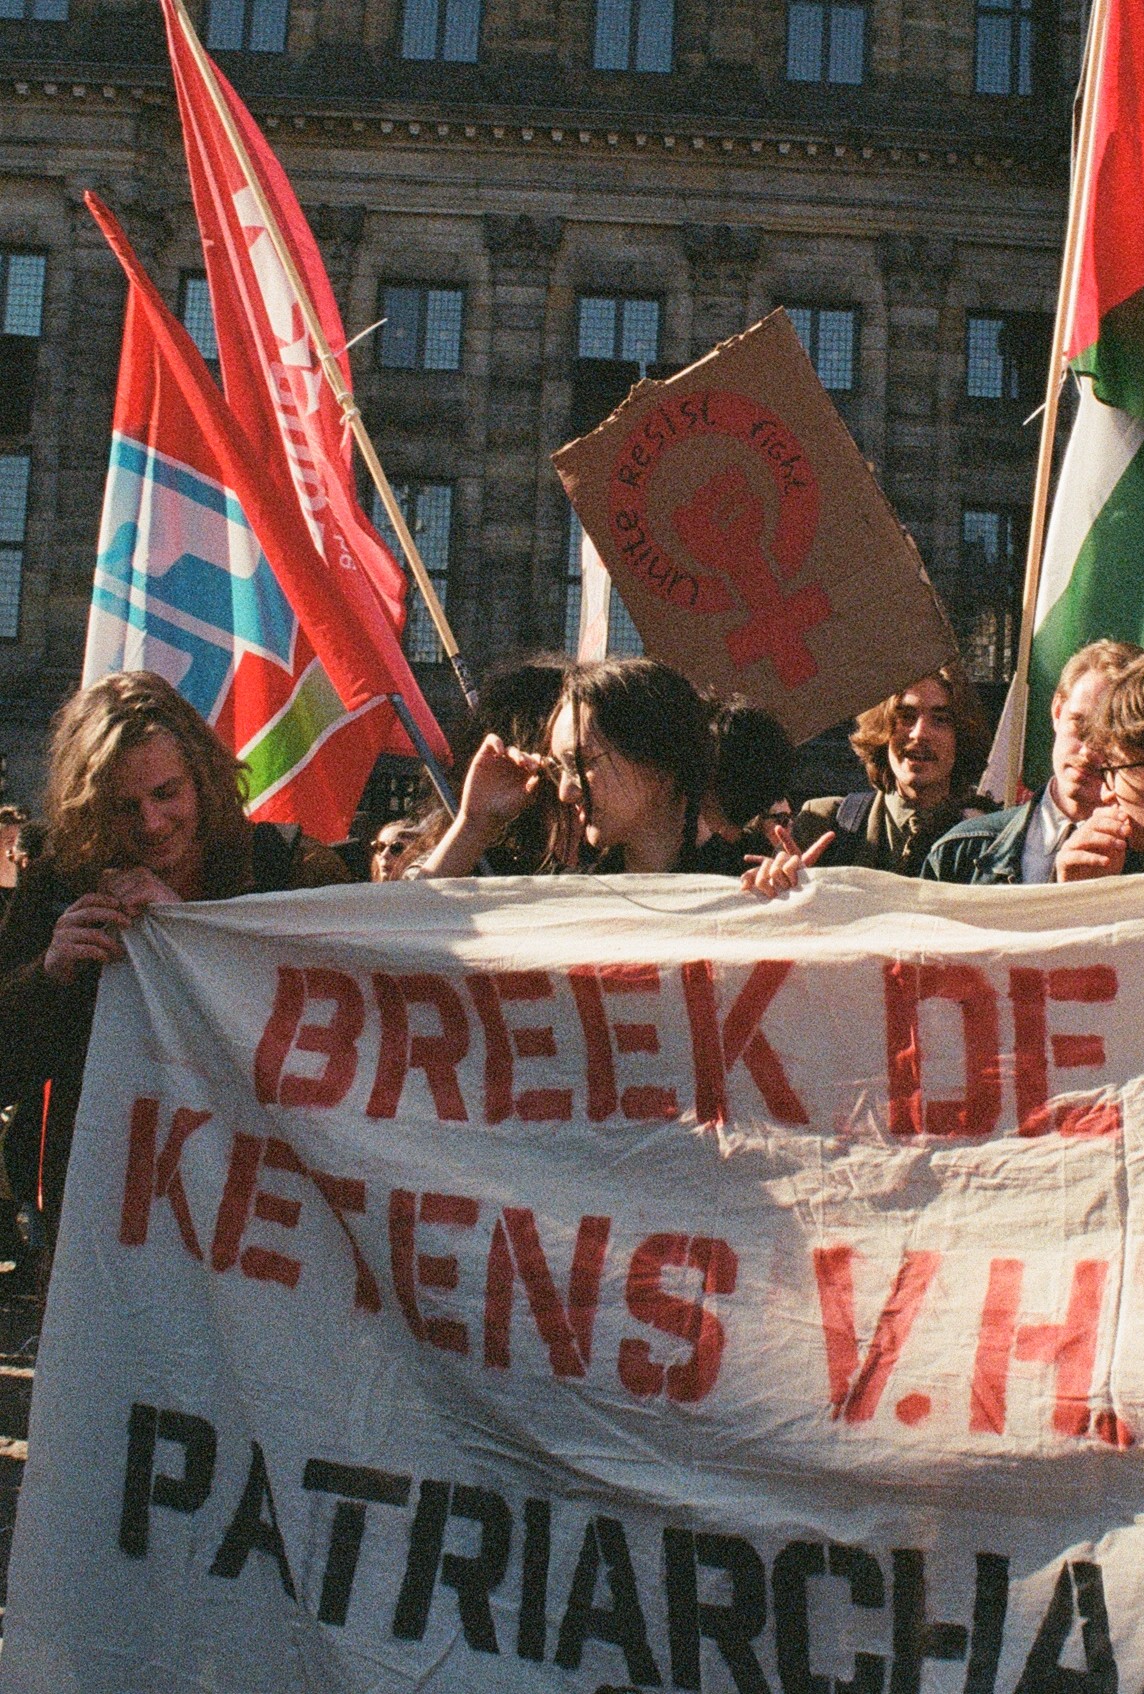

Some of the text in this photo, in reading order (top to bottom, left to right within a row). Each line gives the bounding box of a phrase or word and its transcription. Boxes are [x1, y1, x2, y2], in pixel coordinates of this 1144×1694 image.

[254, 962, 1122, 1138] BREEK DE
[118, 1096, 739, 1403] KETENS
